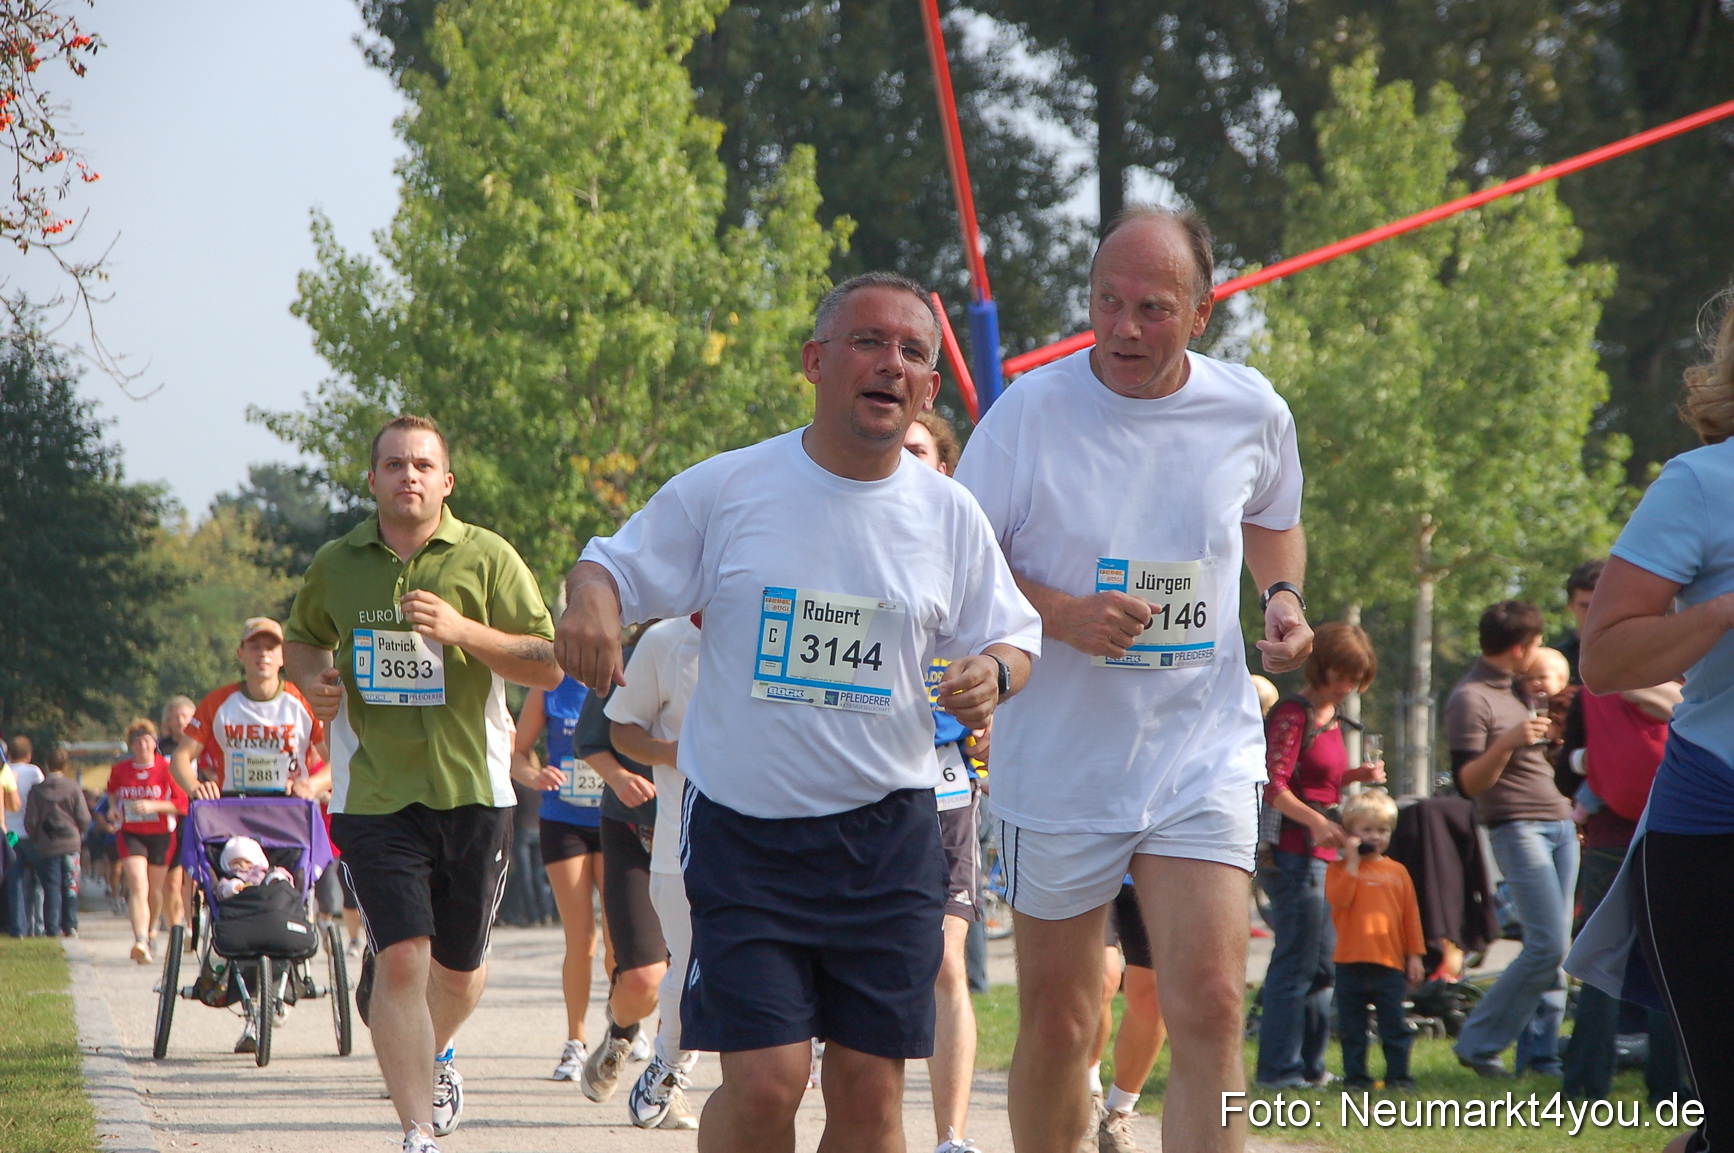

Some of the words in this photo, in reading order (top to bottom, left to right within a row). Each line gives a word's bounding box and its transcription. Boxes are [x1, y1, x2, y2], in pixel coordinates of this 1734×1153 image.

[1135, 570, 1191, 595] Jürgen
[802, 600, 861, 626] Robert
[768, 627, 778, 643] C
[378, 637, 416, 652] Patrick
[800, 634, 883, 672] 3144
[1174, 649, 1215, 661] PFLEIDERER
[359, 656, 365, 667] D
[380, 658, 434, 679] 3633
[840, 692, 891, 707] PFLEIDERER
[248, 769, 280, 781] 2881
